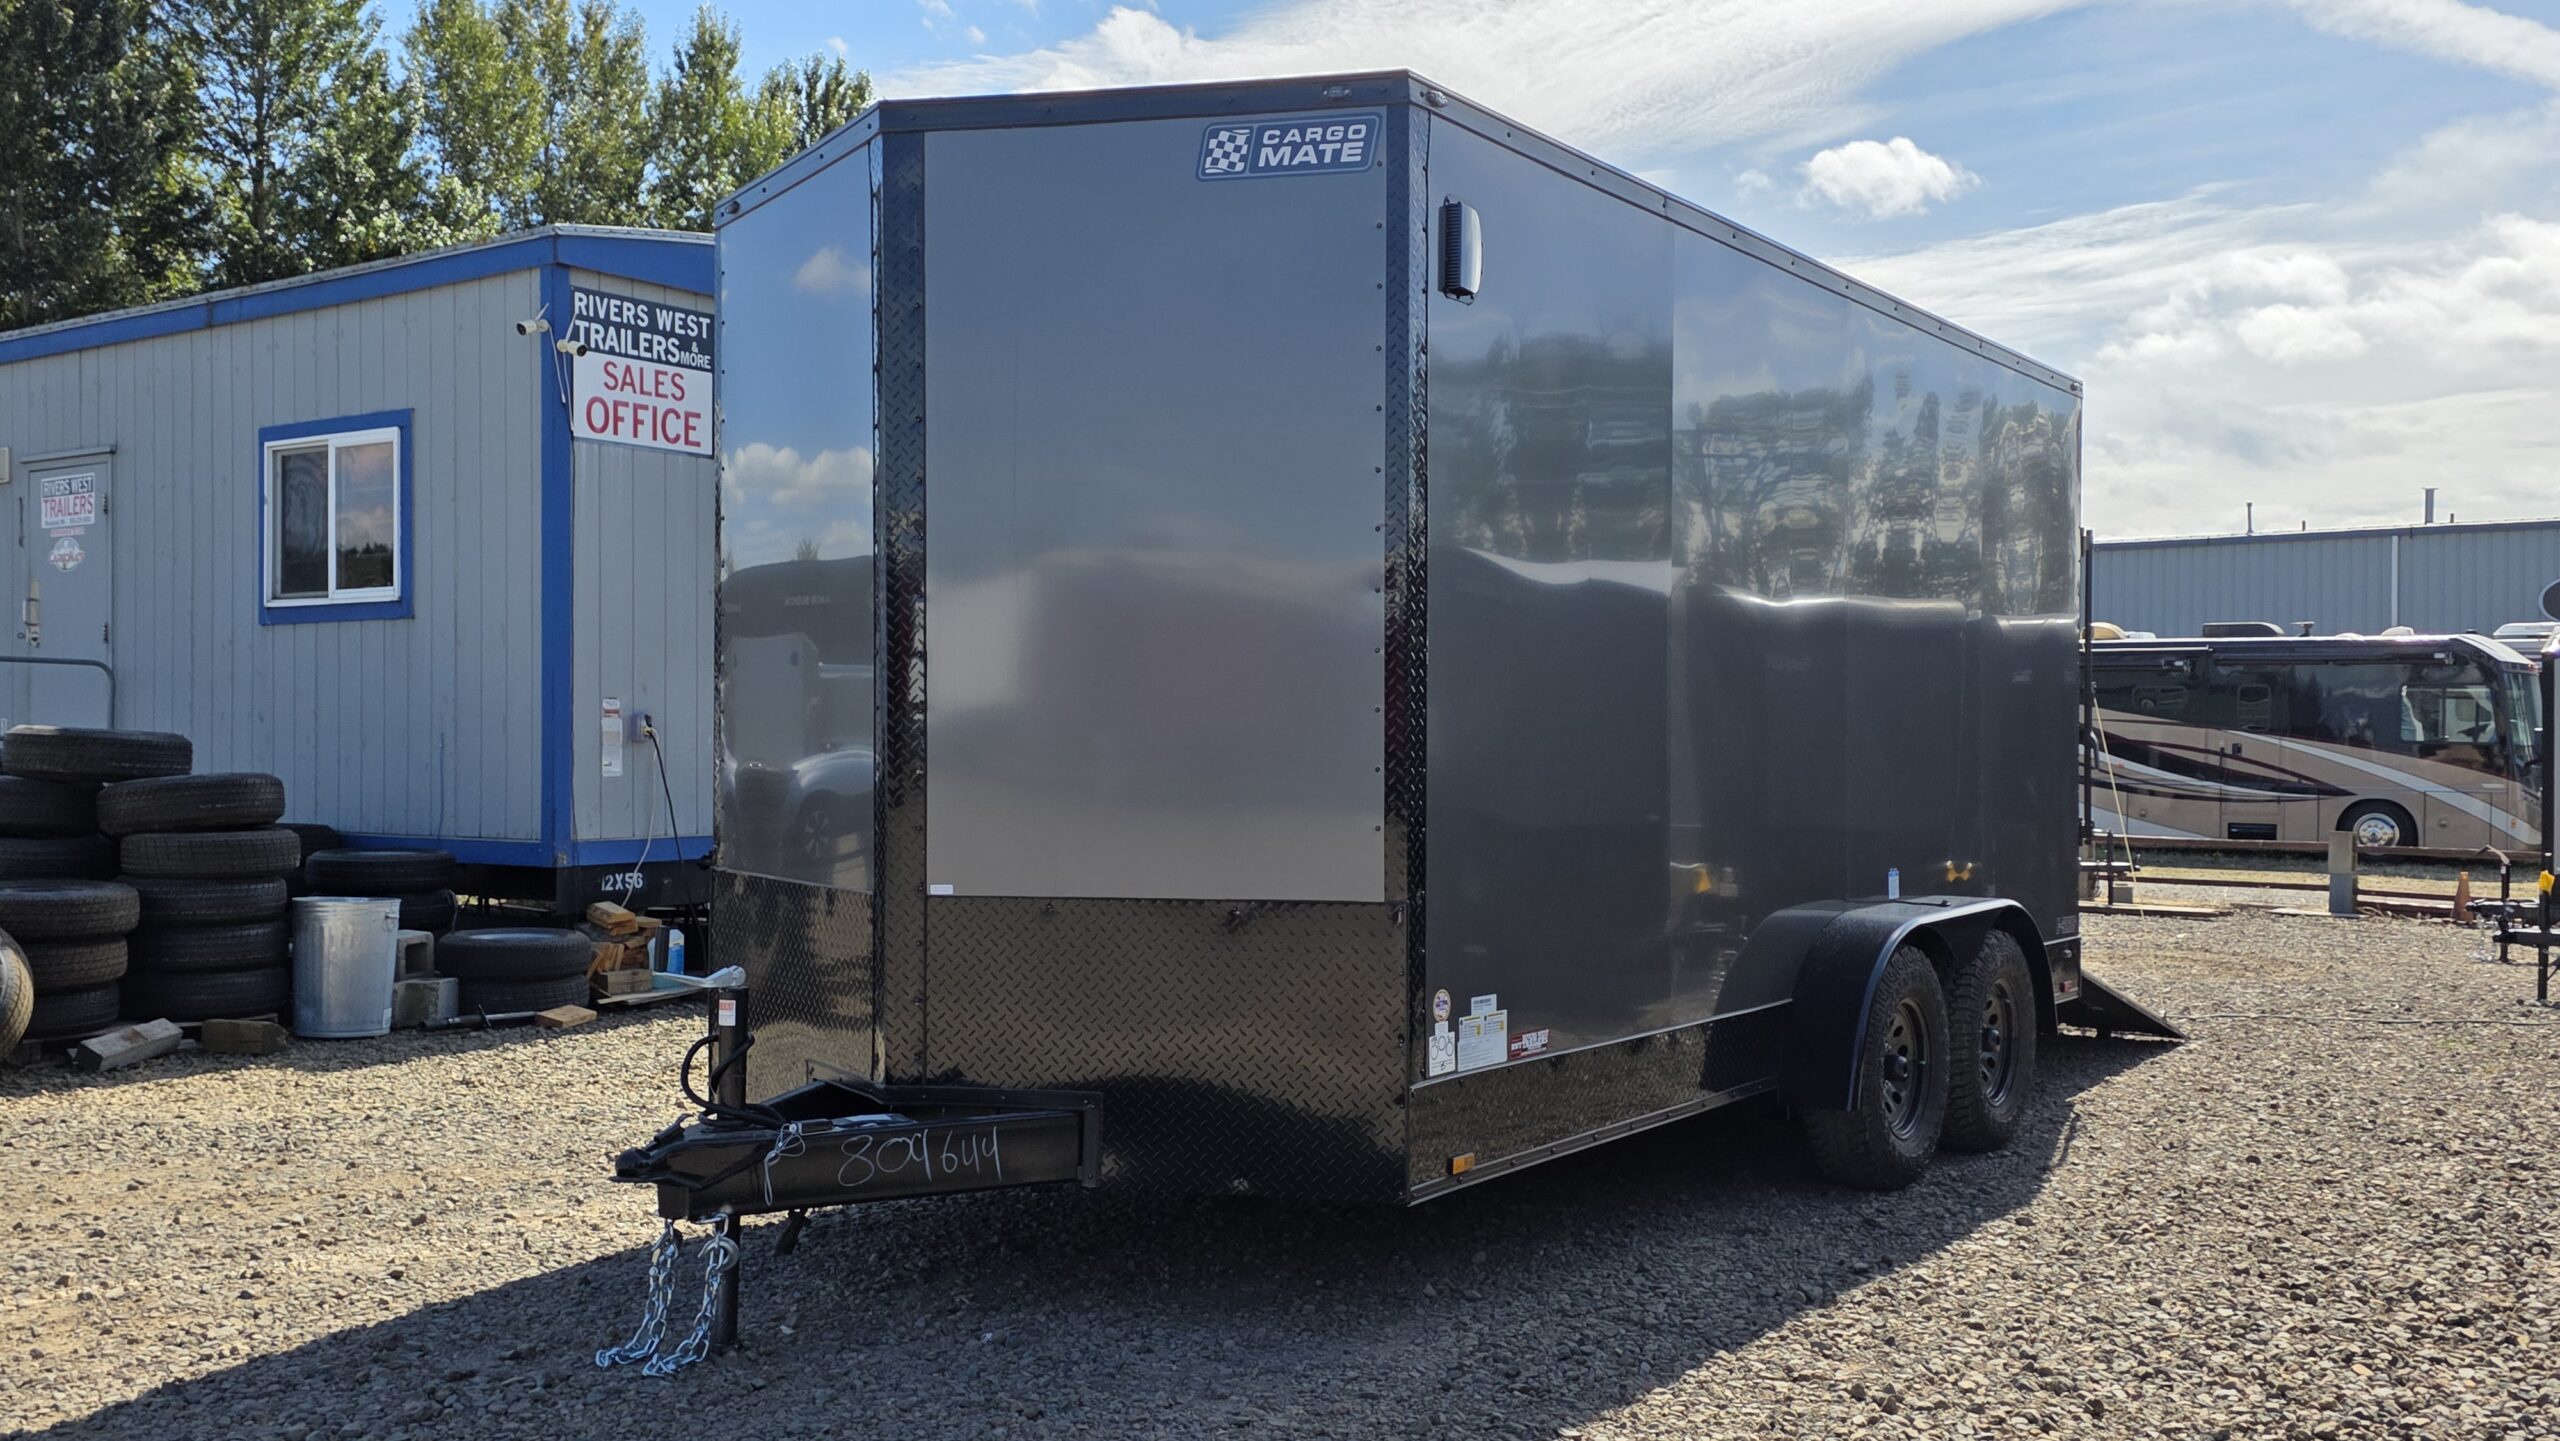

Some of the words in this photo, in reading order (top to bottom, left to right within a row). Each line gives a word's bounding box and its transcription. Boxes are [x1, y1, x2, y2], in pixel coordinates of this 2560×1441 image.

[1263, 124, 1367, 145] CARGO
[1258, 141, 1364, 168] MATE
[574, 291, 649, 328] RIVERS
[656, 308, 711, 339] WEST
[575, 320, 681, 364] TRAILERS
[681, 352, 711, 369] MORE
[603, 360, 686, 402] SALES
[585, 396, 702, 448] OFFICE
[44, 480, 70, 496] RIVERS
[71, 477, 93, 493] WEST
[43, 495, 93, 518] TRAILERS
[601, 872, 643, 891] 12X56
